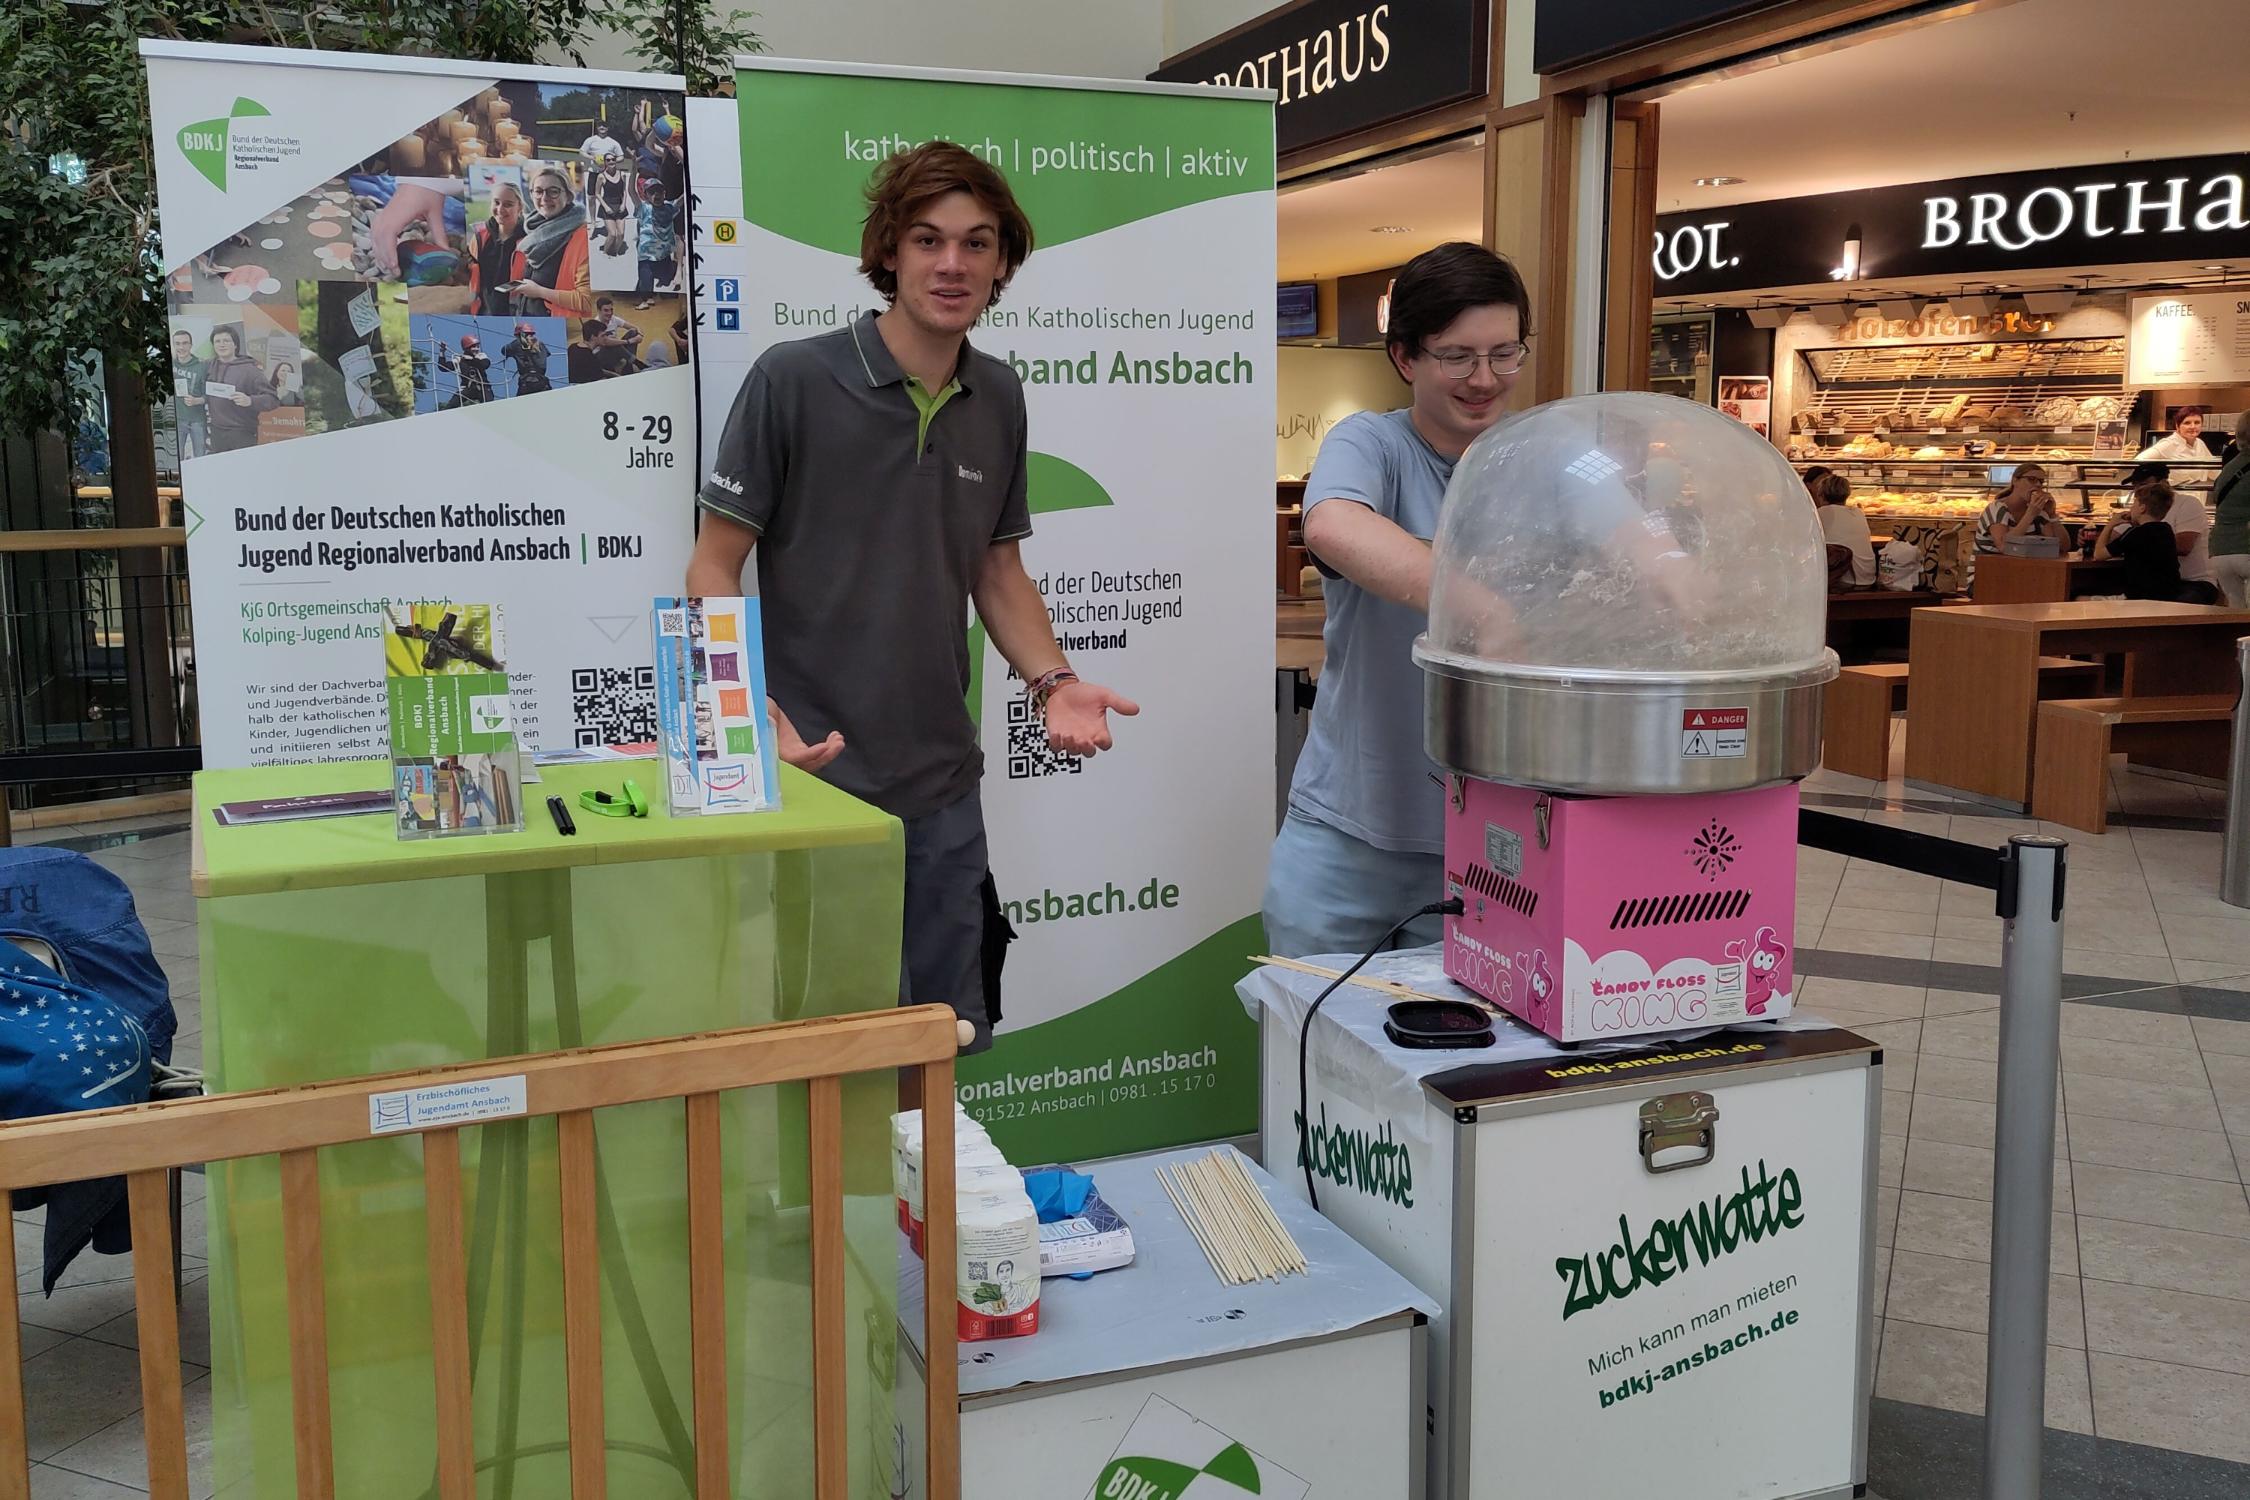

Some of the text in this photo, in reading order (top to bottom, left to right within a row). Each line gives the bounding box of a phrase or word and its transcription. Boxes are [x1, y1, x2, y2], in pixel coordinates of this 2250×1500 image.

[183, 132, 223, 152] BDKJ
[232, 134, 299, 146] Bund der Deutschen
[232, 145, 301, 156] Katholischen Jugend
[234, 155, 280, 163] Regionalverband
[844, 130, 1003, 166] kathch
[1031, 141, 1154, 175] politisch
[1181, 148, 1248, 177] aktiv
[1653, 222, 1741, 280] ROT.
[774, 302, 836, 327] Bund
[1027, 305, 1171, 330] Katholischen
[1177, 308, 1255, 335] Jugend
[1009, 351, 1254, 385] band Ansbach
[603, 411, 619, 441] 8
[641, 415, 673, 445] 29
[625, 446, 674, 469] Jahre
[234, 502, 566, 532] Bund der Deutschen Katholischen
[237, 541, 313, 574] Jugend
[318, 538, 485, 573] Regionalverband
[489, 536, 571, 562] Ansbach
[597, 535, 643, 560] BDKJ
[1055, 571, 1086, 595] der
[1091, 568, 1182, 594] Deutschen
[240, 600, 265, 622] KjG
[266, 597, 392, 620] Ortsgemeinschaft
[1046, 595, 1182, 625] olischen Jugend
[242, 623, 381, 647] Kolping-Jugend Ans
[472, 625, 487, 651] DER
[1055, 629, 1127, 651] alverband
[246, 684, 266, 695] Wir
[270, 683, 295, 694] sind
[298, 681, 318, 692] der
[508, 672, 537, 682] nder-
[247, 698, 271, 709] und
[273, 693, 374, 710] Jugendverbände.
[248, 713, 274, 724] halb
[278, 712, 299, 723] der
[303, 708, 376, 721] katholischen
[520, 700, 538, 710] der
[249, 727, 291, 741] Kinder,
[294, 722, 372, 738] Jugendlichen
[522, 715, 539, 724] ein
[413, 704, 423, 730] BDKJ
[425, 676, 438, 756] Regionalverband
[441, 695, 450, 736] Ansbach
[1711, 715, 1745, 724] DANGER
[250, 743, 274, 755] und
[279, 740, 332, 752] initiieren
[337, 736, 371, 749] selbst
[523, 729, 540, 738] ein
[250, 749, 389, 767] vielfältiges Jahresprogra
[1002, 877, 1180, 925] nsbach.de
[1452, 924, 1512, 970] CANDY FLOSS
[1452, 943, 1513, 1004] KING
[1590, 974, 1707, 997] CANDY FLOSS
[1591, 989, 1708, 1032] KING
[954, 1045, 1218, 1102] ionalverband Ansbach
[1544, 1042, 1767, 1079] bdkj-ansbach.de
[416, 1085, 491, 1102] Erzbischöfliches
[416, 1102, 470, 1116] Jugendamt
[471, 1095, 511, 1109] Ansbach
[975, 1101, 1026, 1123] 91522
[1030, 1091, 1096, 1116] Ansbach
[1109, 1083, 1148, 1103] 0981
[1160, 1079, 1179, 1095] 15
[1183, 1075, 1202, 1092] 17
[1205, 1073, 1216, 1088] 0
[1588, 1273, 1798, 1376] Mich kann man mieten
[1598, 1305, 1800, 1410] bdkj-ansbach.de
